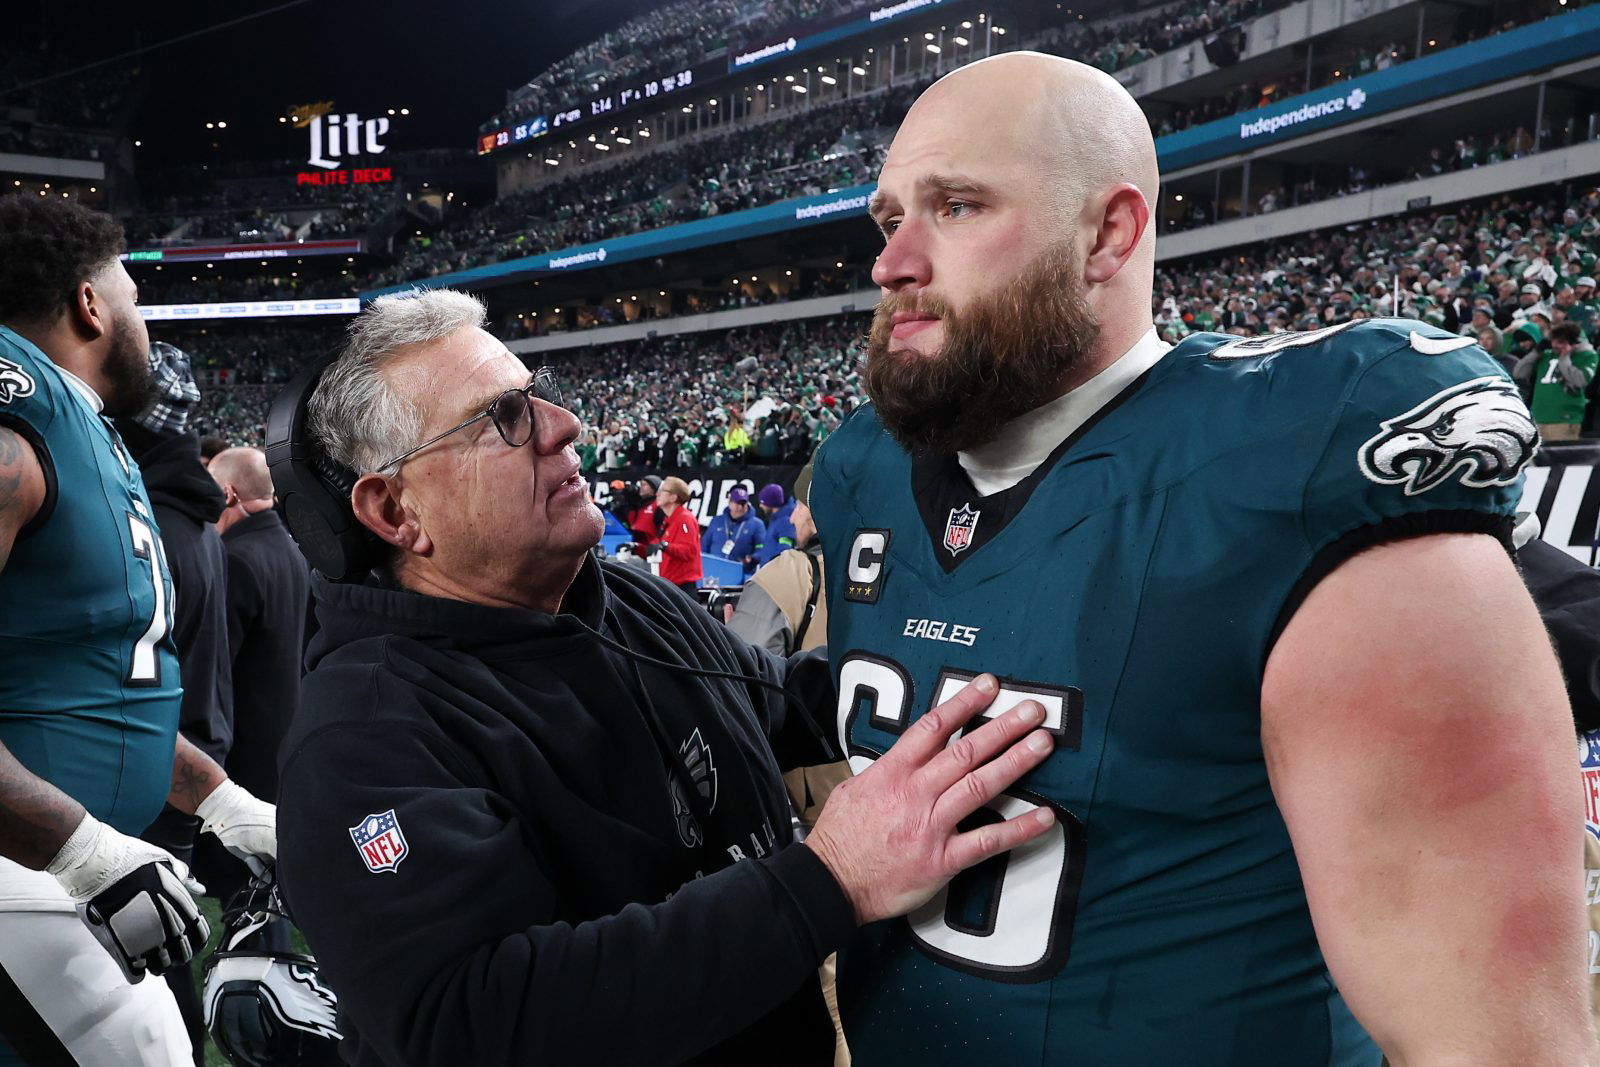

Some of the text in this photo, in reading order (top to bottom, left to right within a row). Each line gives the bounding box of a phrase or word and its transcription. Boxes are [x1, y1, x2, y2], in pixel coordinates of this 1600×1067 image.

[1240, 98, 1345, 139] Independence
[308, 113, 389, 169] Lite
[353, 168, 393, 183] DECK
[796, 196, 867, 219] Independence
[948, 526, 970, 546] NFL
[848, 533, 885, 584] C
[902, 618, 981, 647] EAGLES
[362, 831, 404, 867] NFL
